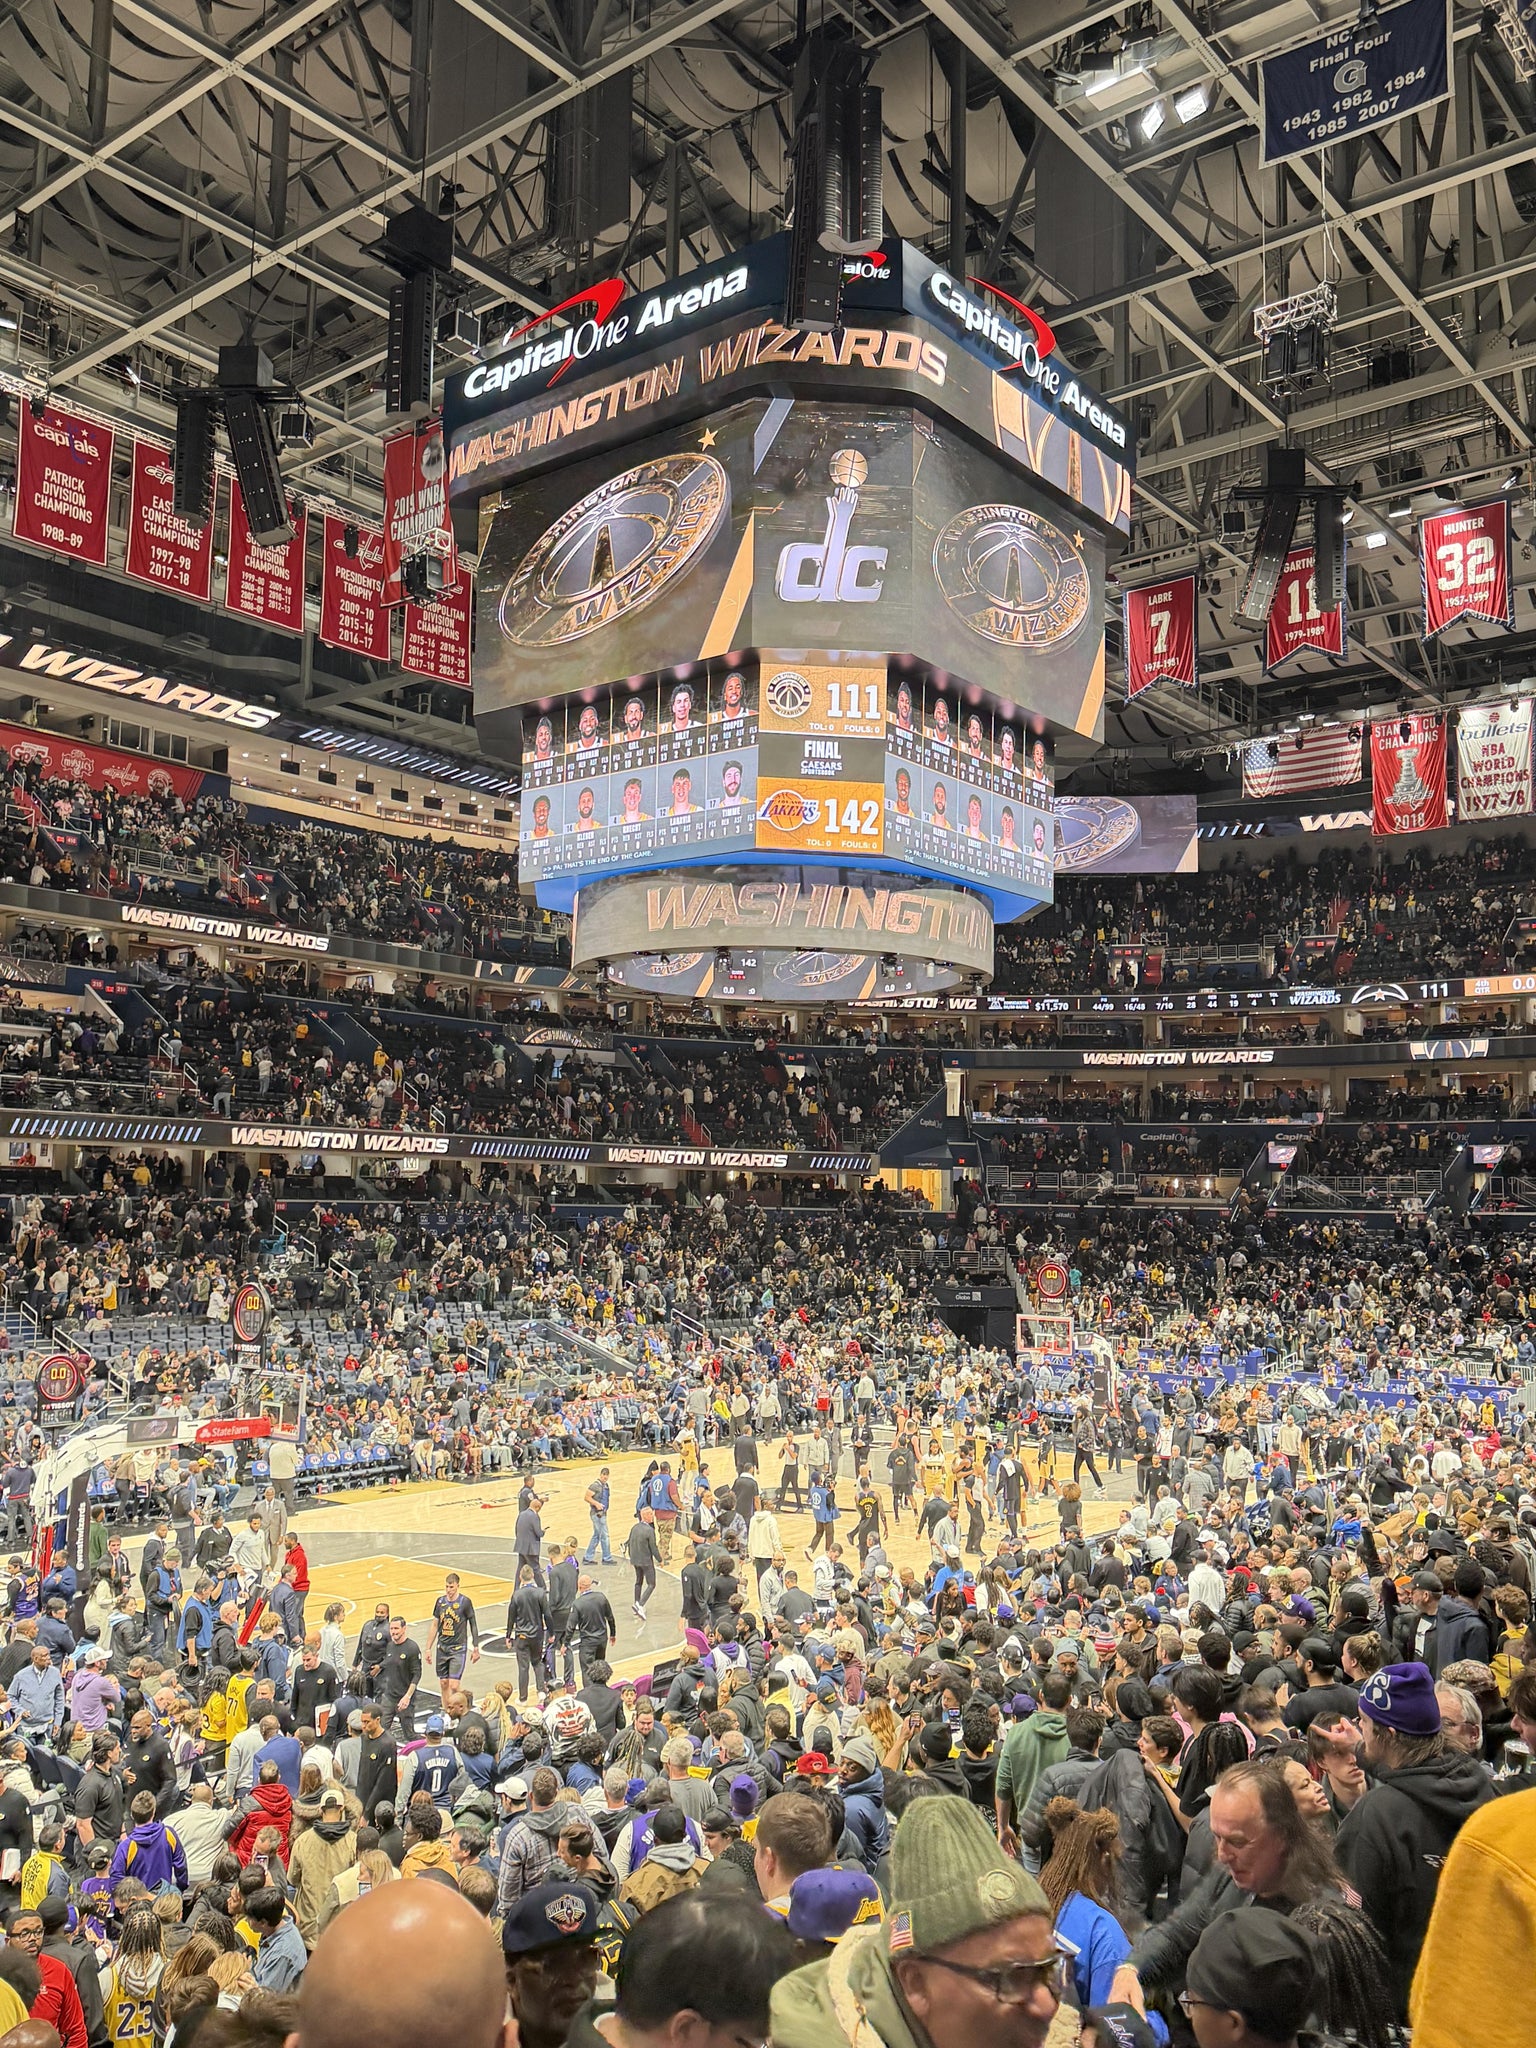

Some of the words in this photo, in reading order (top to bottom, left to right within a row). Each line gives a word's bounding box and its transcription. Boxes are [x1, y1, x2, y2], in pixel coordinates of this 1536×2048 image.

[1326, 30, 1354, 50] NC
[1309, 48, 1349, 73] Final
[1354, 31, 1392, 55] Four
[1281, 109, 1321, 133] 1943
[1332, 89, 1373, 114] 1982
[1384, 66, 1426, 94] 1984
[1307, 116, 1347, 141] 1985
[1358, 95, 1400, 123] 2007
[842, 262, 890, 280] alOne
[634, 265, 749, 335] Arena
[448, 355, 685, 481] WASHINGTON
[699, 318, 948, 387] WIZARDS
[1059, 379, 1127, 449] Arena
[44, 466, 85, 494] PATRICK
[144, 465, 175, 485] cap
[42, 481, 86, 507] DIVISION
[393, 494, 416, 520] 2019
[418, 483, 446, 508] WNBA
[34, 492, 93, 524] CHAMPIONS
[153, 495, 175, 515] EAST
[41, 522, 83, 548] 1988-89
[143, 522, 200, 551] CHAMPIONS
[1443, 517, 1485, 536] HUNTER
[245, 531, 291, 558] SOEAST
[150, 545, 191, 571] 1997-98
[250, 545, 285, 567] DIVISION
[1283, 557, 1316, 574] GARTN
[1436, 536, 1496, 591] 32
[149, 563, 190, 586] 2017-18
[244, 555, 290, 581] CHAMPIONS
[335, 566, 382, 593] PRESIDENTS
[343, 581, 373, 602] TROPHY
[1148, 591, 1173, 606] LABRE
[339, 598, 374, 621] 2009-10
[412, 601, 465, 622] TROPOLITAN
[422, 610, 455, 629] DIVISION
[338, 613, 374, 636] 2015-16
[416, 619, 460, 642] CHAMPIONS
[1150, 610, 1171, 655] 7
[1284, 625, 1326, 642] 1979-1989
[338, 627, 373, 650] 2016-17
[408, 632, 436, 648] 2015-16
[408, 645, 435, 660] 2016-17
[19, 643, 281, 729] WIZARDS
[826, 681, 881, 720] 111
[844, 724, 873, 733] FOULS:
[1374, 718, 1418, 738] STANY
[1422, 717, 1438, 730] CU
[1459, 721, 1529, 741] bullets
[803, 739, 842, 760] FINAL
[1481, 742, 1505, 758] NBA
[800, 759, 843, 771] CAESARS
[1472, 756, 1515, 773] WORLD
[1460, 768, 1530, 789] CHAMPIONS
[709, 799, 717, 808] 17
[761, 800, 808, 822] LAKERS
[1465, 789, 1526, 813] 1977-78
[824, 797, 880, 836] 142
[1299, 810, 1374, 832] WA
[1394, 811, 1425, 831] 2018
[841, 840, 871, 850] FOULS:
[564, 861, 584, 869] THAT'S
[647, 881, 991, 951] WASHINGTON
[121, 905, 242, 938] WASHINGTON
[246, 925, 330, 952] WIZARDS
[740, 958, 757, 967] 142
[723, 986, 735, 995] 0.0
[884, 984, 896, 992] 0.0
[1419, 982, 1449, 999] 111
[1512, 976, 1535, 991] 0.0
[1034, 1002, 1069, 1012] $11,570
[1092, 1002, 1115, 1011] 44/99
[1124, 1003, 1146, 1011] 16/48
[1155, 1002, 1174, 1010] 7/10
[1186, 1001, 1197, 1009] 28
[1207, 1000, 1218, 1008] 44
[1288, 993, 1342, 1005] WIZARDS
[1082, 1052, 1186, 1065] WASHINGTON
[1190, 1050, 1275, 1064] WIZARDS
[231, 1126, 358, 1150] WASHINGTON
[363, 1133, 449, 1154] WIZARDS
[607, 1147, 706, 1166] WASHINGTON
[709, 1150, 789, 1168] WIZARDS
[241, 1344, 262, 1353] TISSOT
[51, 1368, 67, 1380] 0.0
[51, 1401, 76, 1410] TISSOT
[430, 1768, 440, 1786] 0
[116, 1999, 155, 2041] 23
